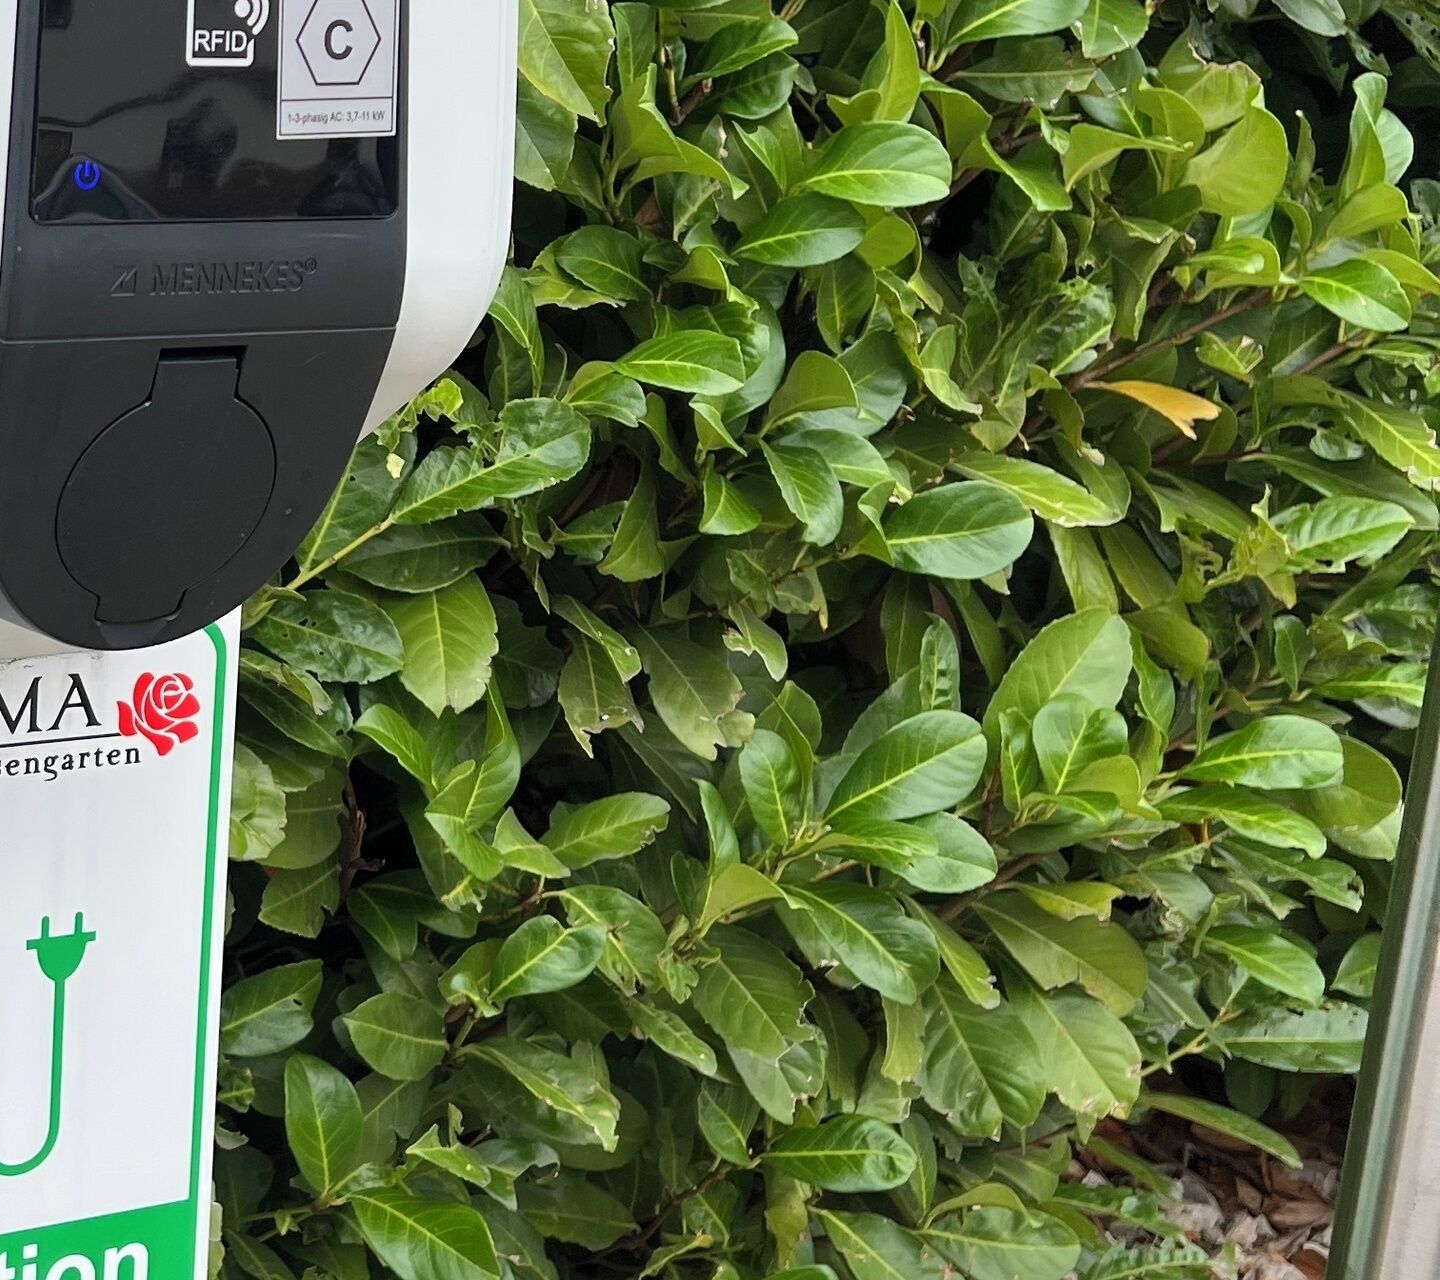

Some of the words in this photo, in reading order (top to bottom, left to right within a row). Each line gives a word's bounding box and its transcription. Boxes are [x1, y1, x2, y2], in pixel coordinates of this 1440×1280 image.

[193, 29, 248, 52] RFID
[324, 19, 353, 60] C
[372, 109, 385, 121] kW
